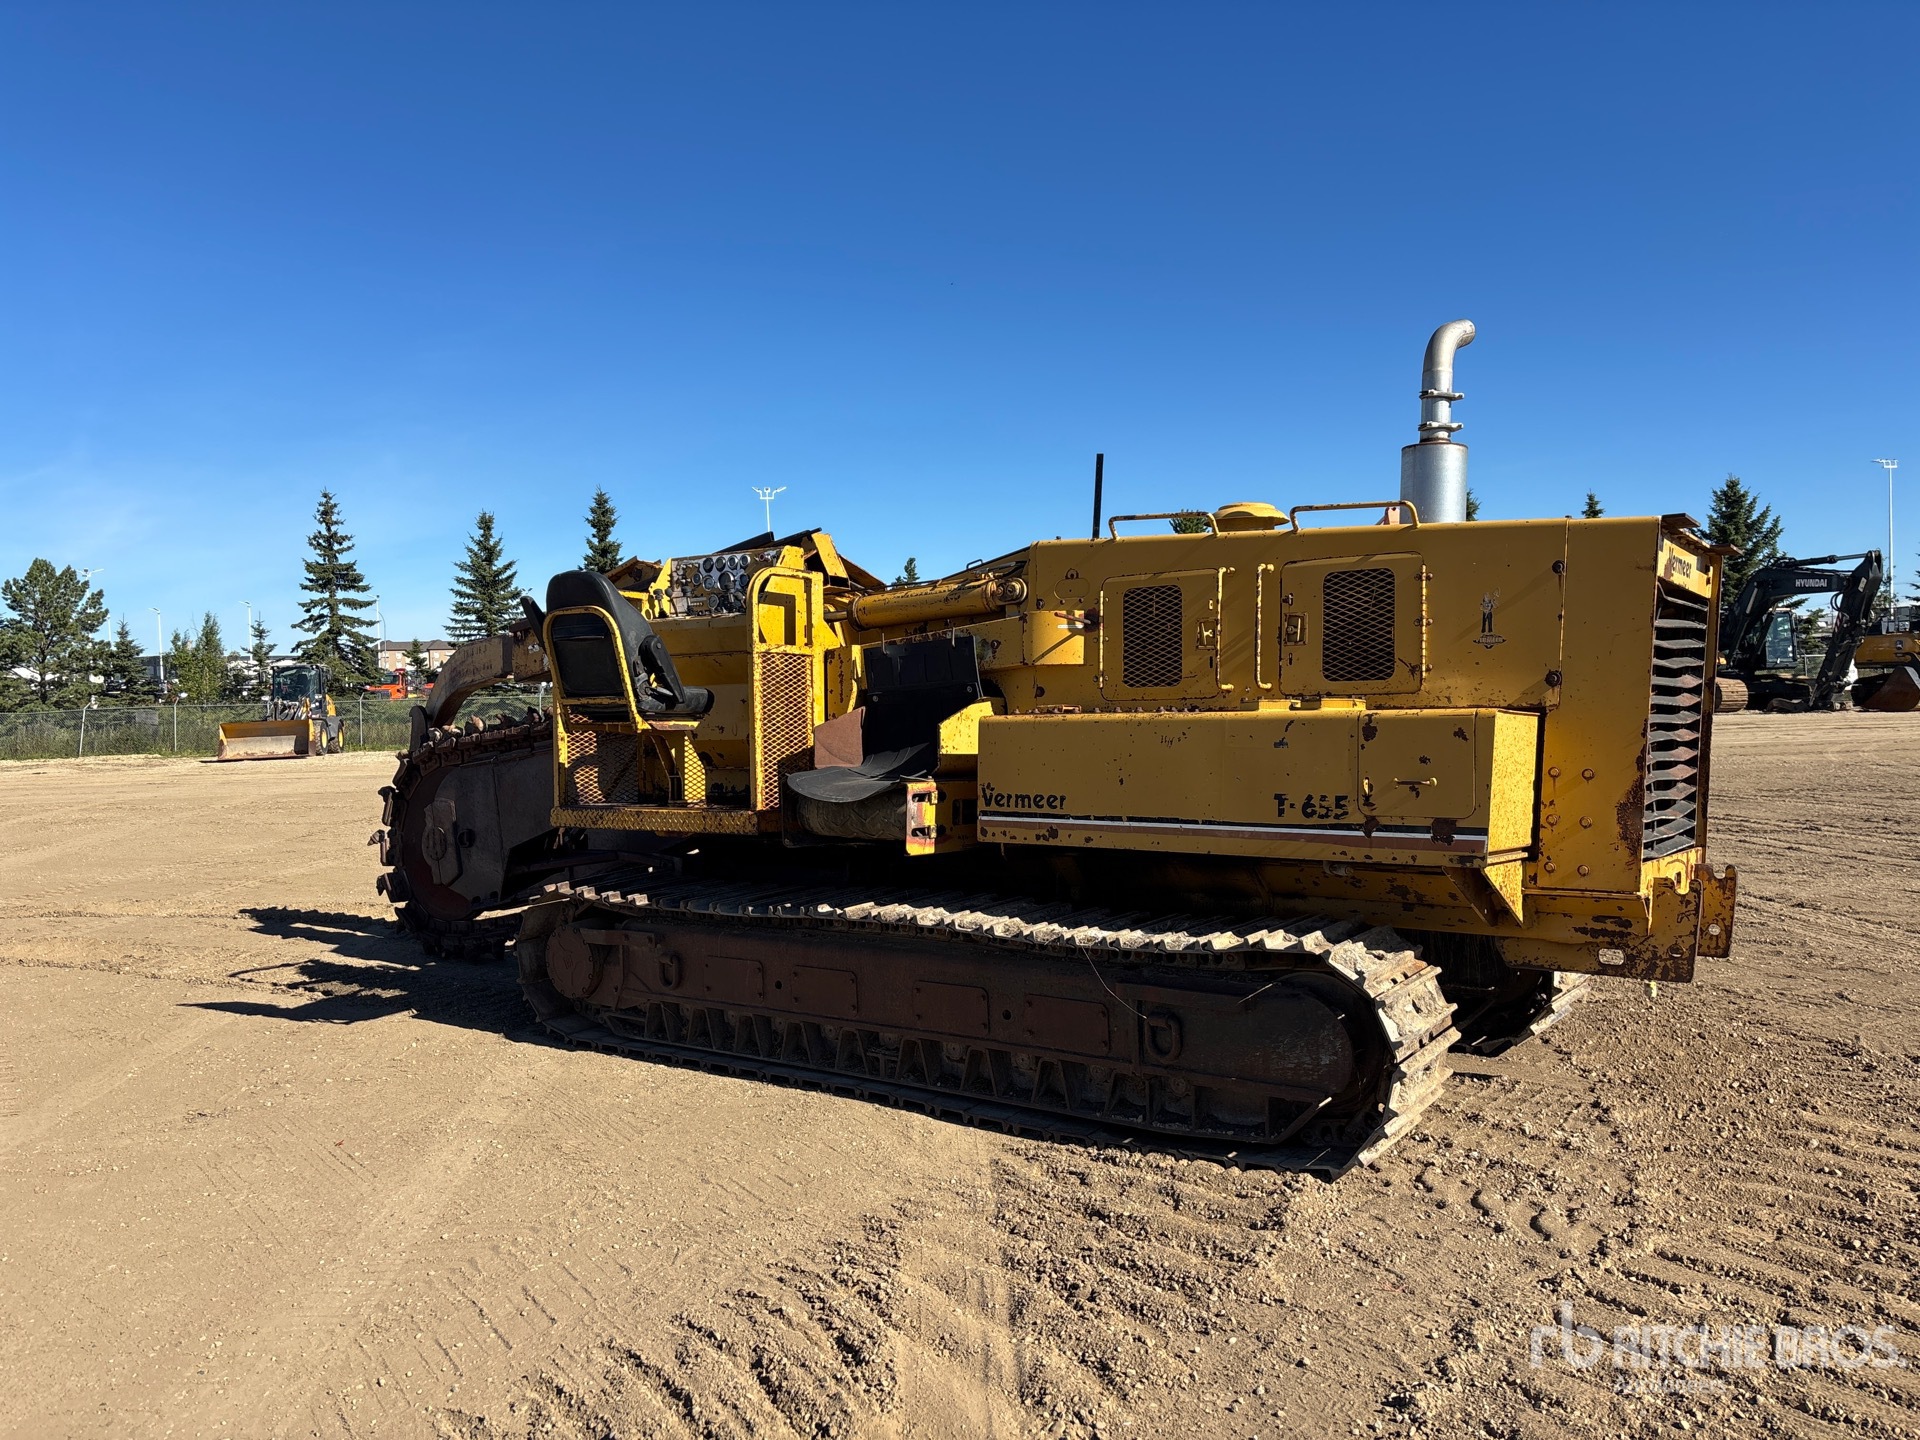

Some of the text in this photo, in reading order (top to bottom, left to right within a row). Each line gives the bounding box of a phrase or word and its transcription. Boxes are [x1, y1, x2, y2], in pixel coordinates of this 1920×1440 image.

[1795, 579, 1828, 588] HYUNDAI
[981, 785, 1067, 810] Vermeer
[1273, 793, 1350, 820] T-655
